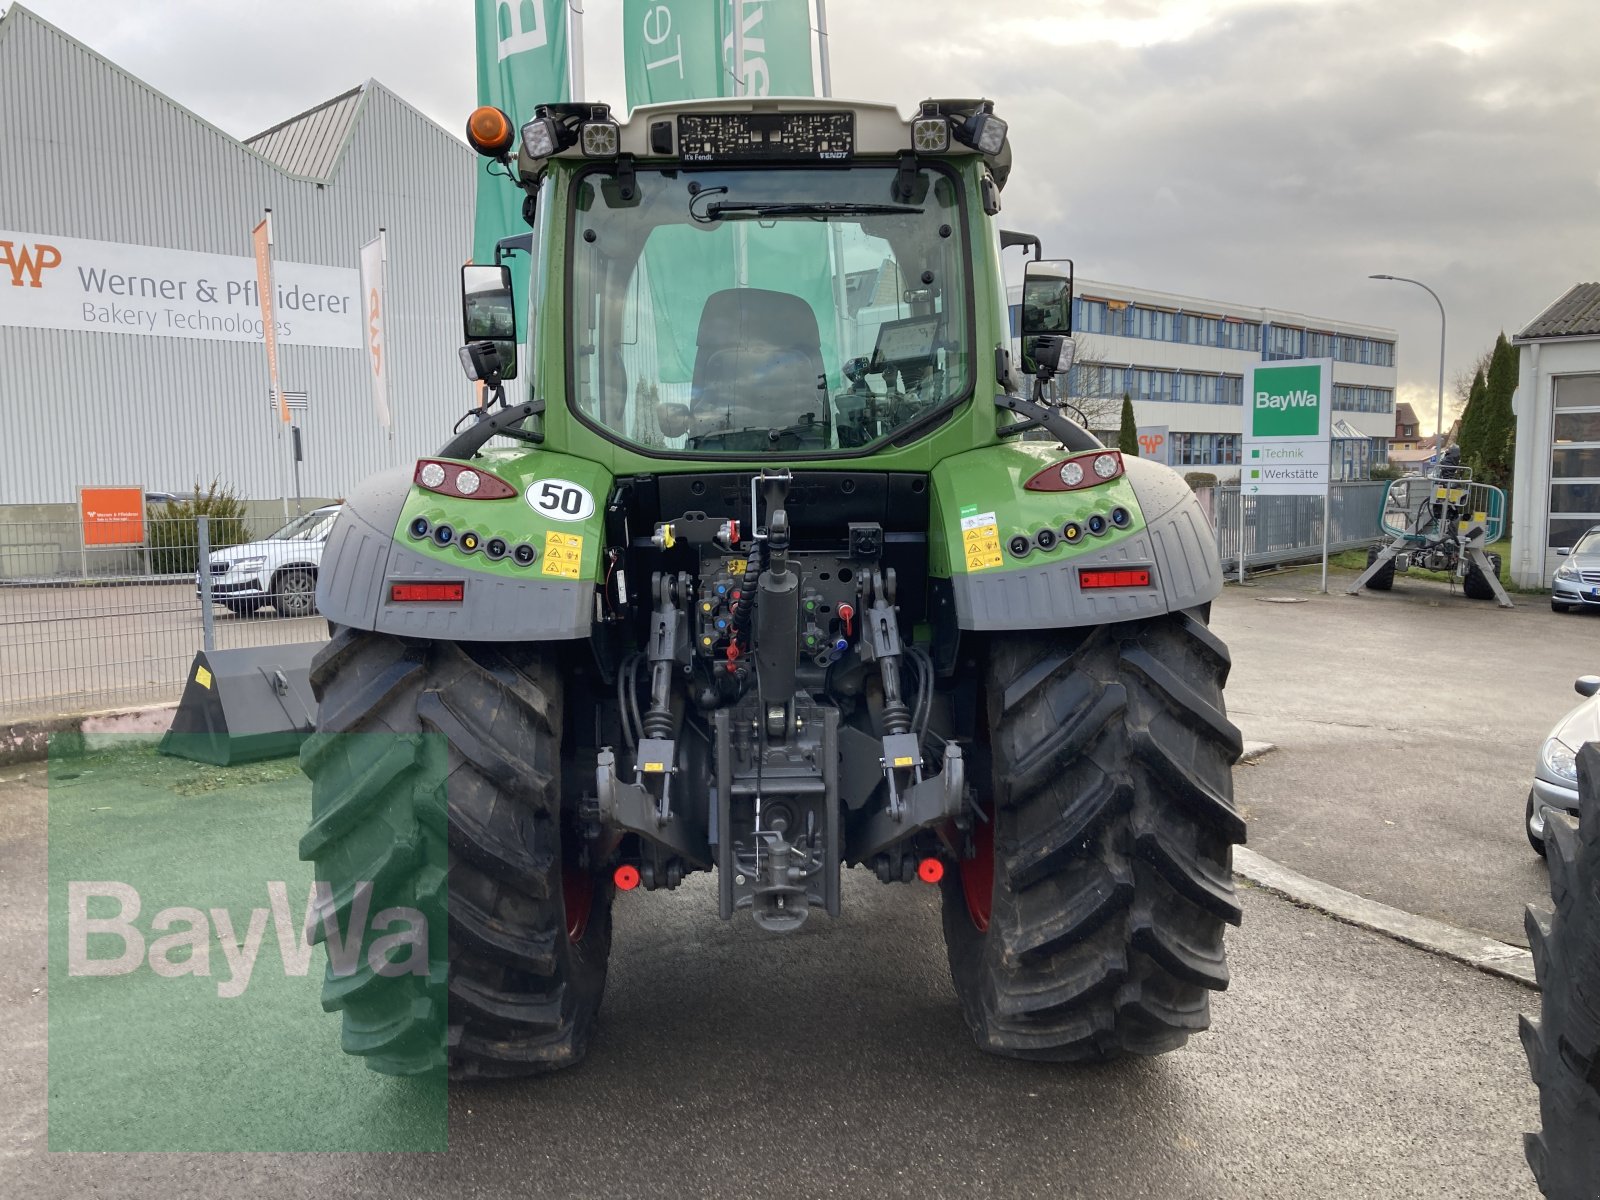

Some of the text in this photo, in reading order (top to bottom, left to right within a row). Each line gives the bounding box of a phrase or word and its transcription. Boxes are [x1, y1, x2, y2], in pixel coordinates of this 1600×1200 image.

[77, 266, 350, 314] Werner & Pfliderer
[82, 301, 293, 340] Bakery Technologes
[1255, 389, 1318, 411] BayWa
[1264, 448, 1304, 458] Technik
[1263, 469, 1319, 479] Werkstätte
[538, 482, 583, 515] 50
